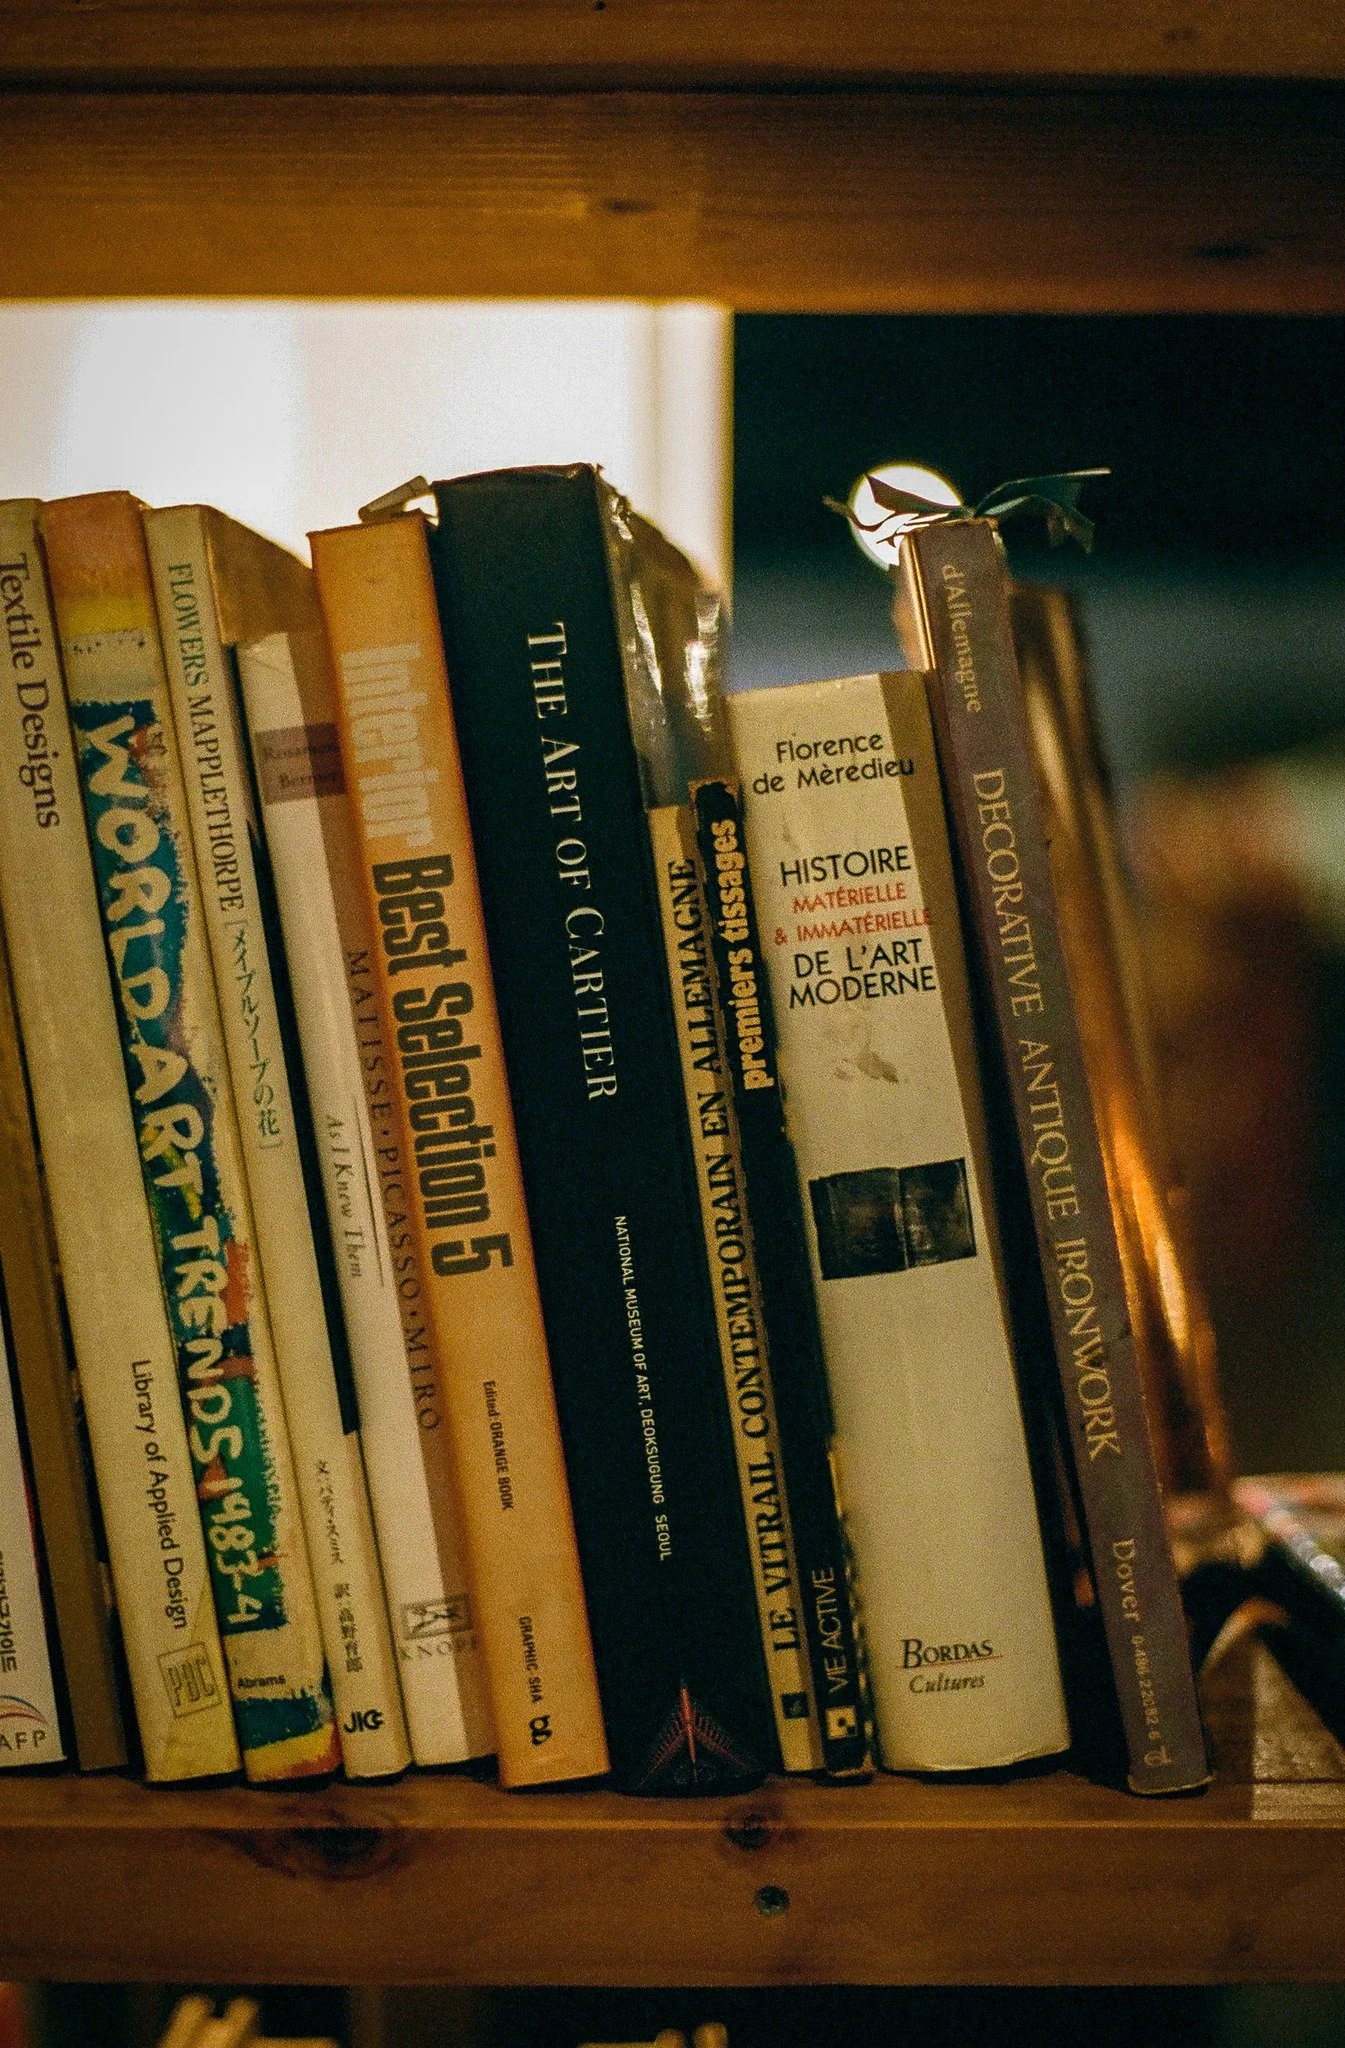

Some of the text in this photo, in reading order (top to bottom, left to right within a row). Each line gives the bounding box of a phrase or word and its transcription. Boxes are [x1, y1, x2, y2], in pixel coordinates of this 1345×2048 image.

[1, 552, 61, 830] Textile Designs
[168, 562, 245, 912] FLOWERS MAPPLETHORPE
[340, 642, 440, 849] Interior
[776, 733, 884, 764] Florence
[752, 774, 785, 795] de
[527, 621, 618, 1101] THE ART OF CARTIER
[780, 846, 912, 887] HISTOIRE
[792, 882, 907, 915] MATÉRIELLE
[711, 818, 775, 1090] premiers tissages
[774, 928, 788, 946] &
[793, 938, 923, 979] DE L'ART
[789, 966, 936, 1010] MODERNE
[372, 853, 513, 1277] Best Selection 5
[326, 1115, 345, 1140] As
[346, 949, 390, 1116] MATISSE
[378, 1146, 421, 1298] PICASSO
[973, 768, 1121, 1462] DECORATIVE ANTIQUE IRONWORK
[82, 714, 263, 1624] WORLD ART TRENDS 1983-4
[333, 1162, 352, 1219] Knew
[343, 1227, 363, 1277] Them
[615, 1215, 637, 1285] NATIONAL
[668, 858, 799, 1652] LE VITRAIL CONTEMPORAIN EN ALLEMAGNE
[624, 1288, 647, 1350] MUSEUM
[633, 1353, 647, 1375] OF
[483, 1381, 515, 1511] Edited ORANGE BOOK
[640, 1408, 665, 1504] DEOKSUGUNG
[131, 1360, 189, 1629] Library of Applied Design
[655, 1514, 672, 1561] SEOUL
[1112, 1538, 1141, 1623] Dover
[518, 1615, 540, 1673] GRAPHIC
[811, 1567, 850, 1694] VIE ACTIVE
[238, 1674, 286, 1690] Abrams
[909, 1672, 985, 1694] Cultures
